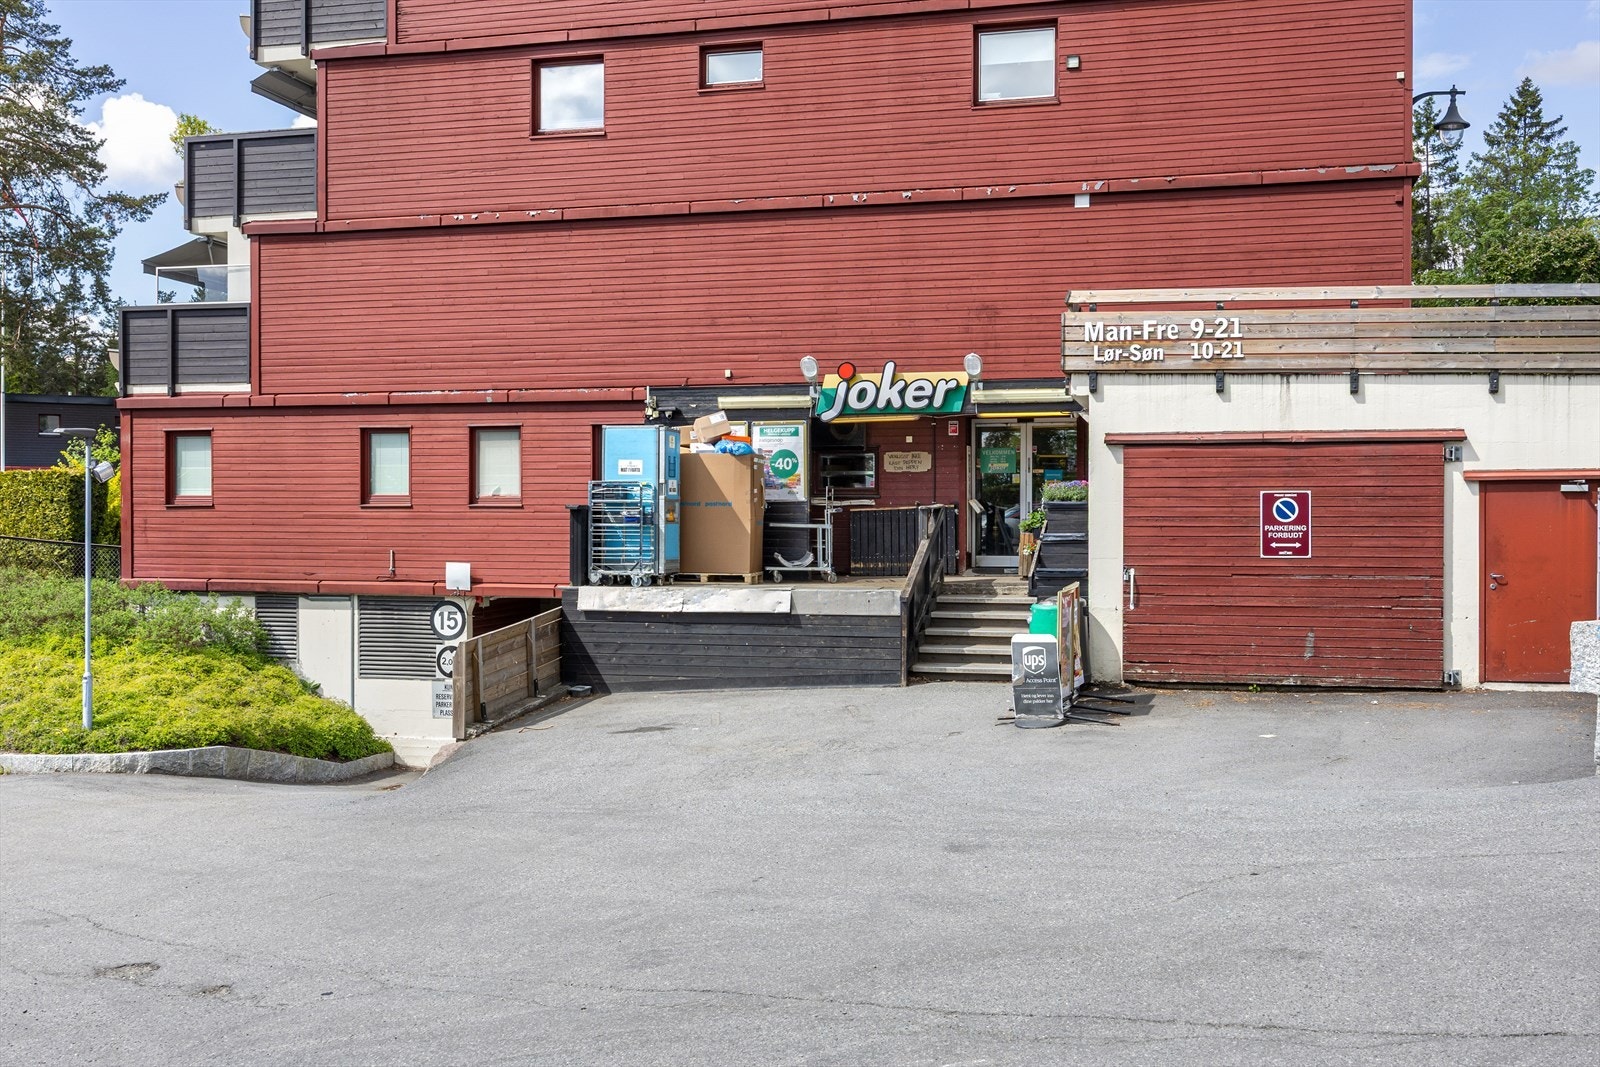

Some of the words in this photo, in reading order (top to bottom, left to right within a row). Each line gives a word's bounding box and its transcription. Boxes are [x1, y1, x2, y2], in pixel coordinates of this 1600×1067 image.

[1084, 319, 1179, 342] Man-Fre
[1190, 317, 1243, 339] 9-21
[1093, 344, 1164, 363] Lør-Søn
[1190, 341, 1245, 360] 10-21
[820, 360, 958, 423] joker
[771, 457, 798, 470] -40%
[438, 610, 459, 630] 15
[1024, 654, 1045, 670] ups
